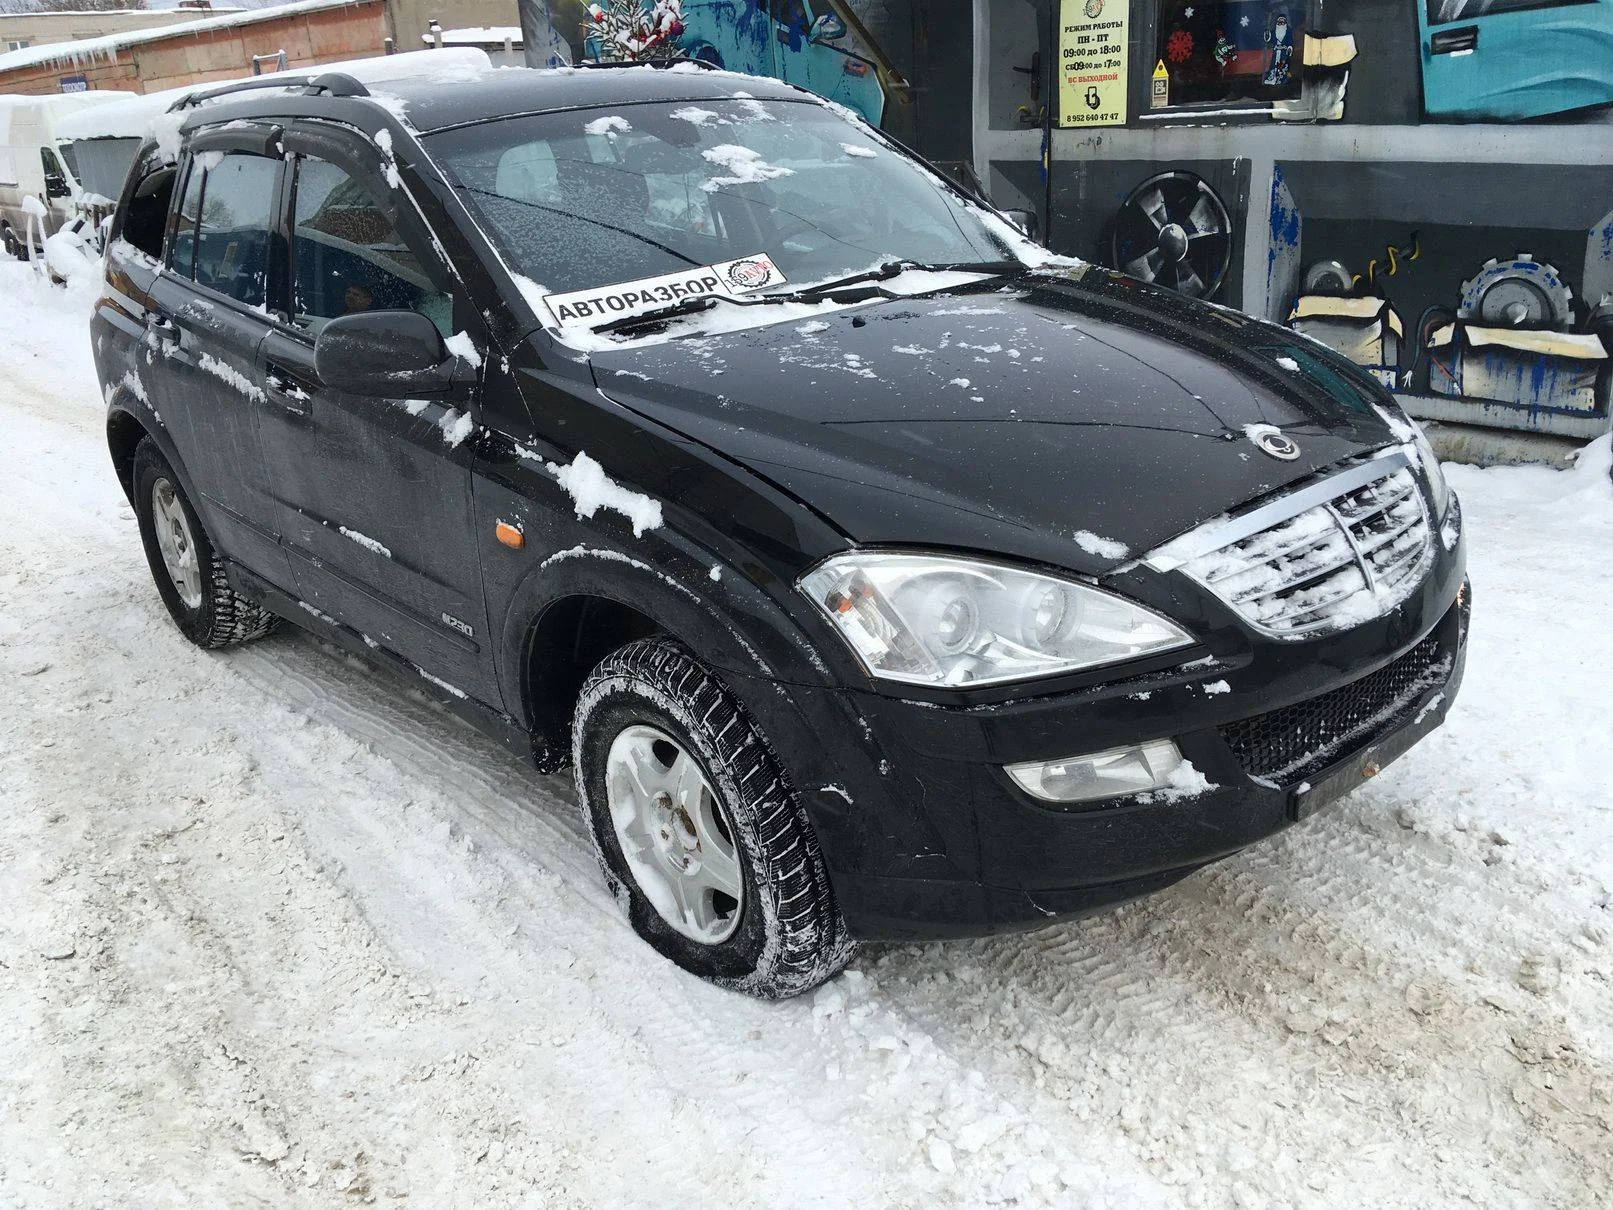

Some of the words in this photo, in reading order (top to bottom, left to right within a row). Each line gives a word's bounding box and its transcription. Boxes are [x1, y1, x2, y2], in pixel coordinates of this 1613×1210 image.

[1064, 24, 1092, 33] РЕЖИМ
[1093, 21, 1123, 31] РАБОТЫ
[1077, 36, 1090, 44] ПН
[1097, 34, 1109, 43] ПТ
[1063, 48, 1086, 58] 09:00
[1100, 45, 1121, 55] 18:00
[1103, 59, 1121, 68] 17:00
[1067, 75, 1078, 83] ВС
[1078, 73, 1118, 83] ВЫХОДНОЙ
[1072, 114, 1085, 122] 952
[1086, 113, 1098, 121] 640
[1110, 112, 1119, 120] 47
[558, 276, 719, 321] АВТОРАЗБОР
